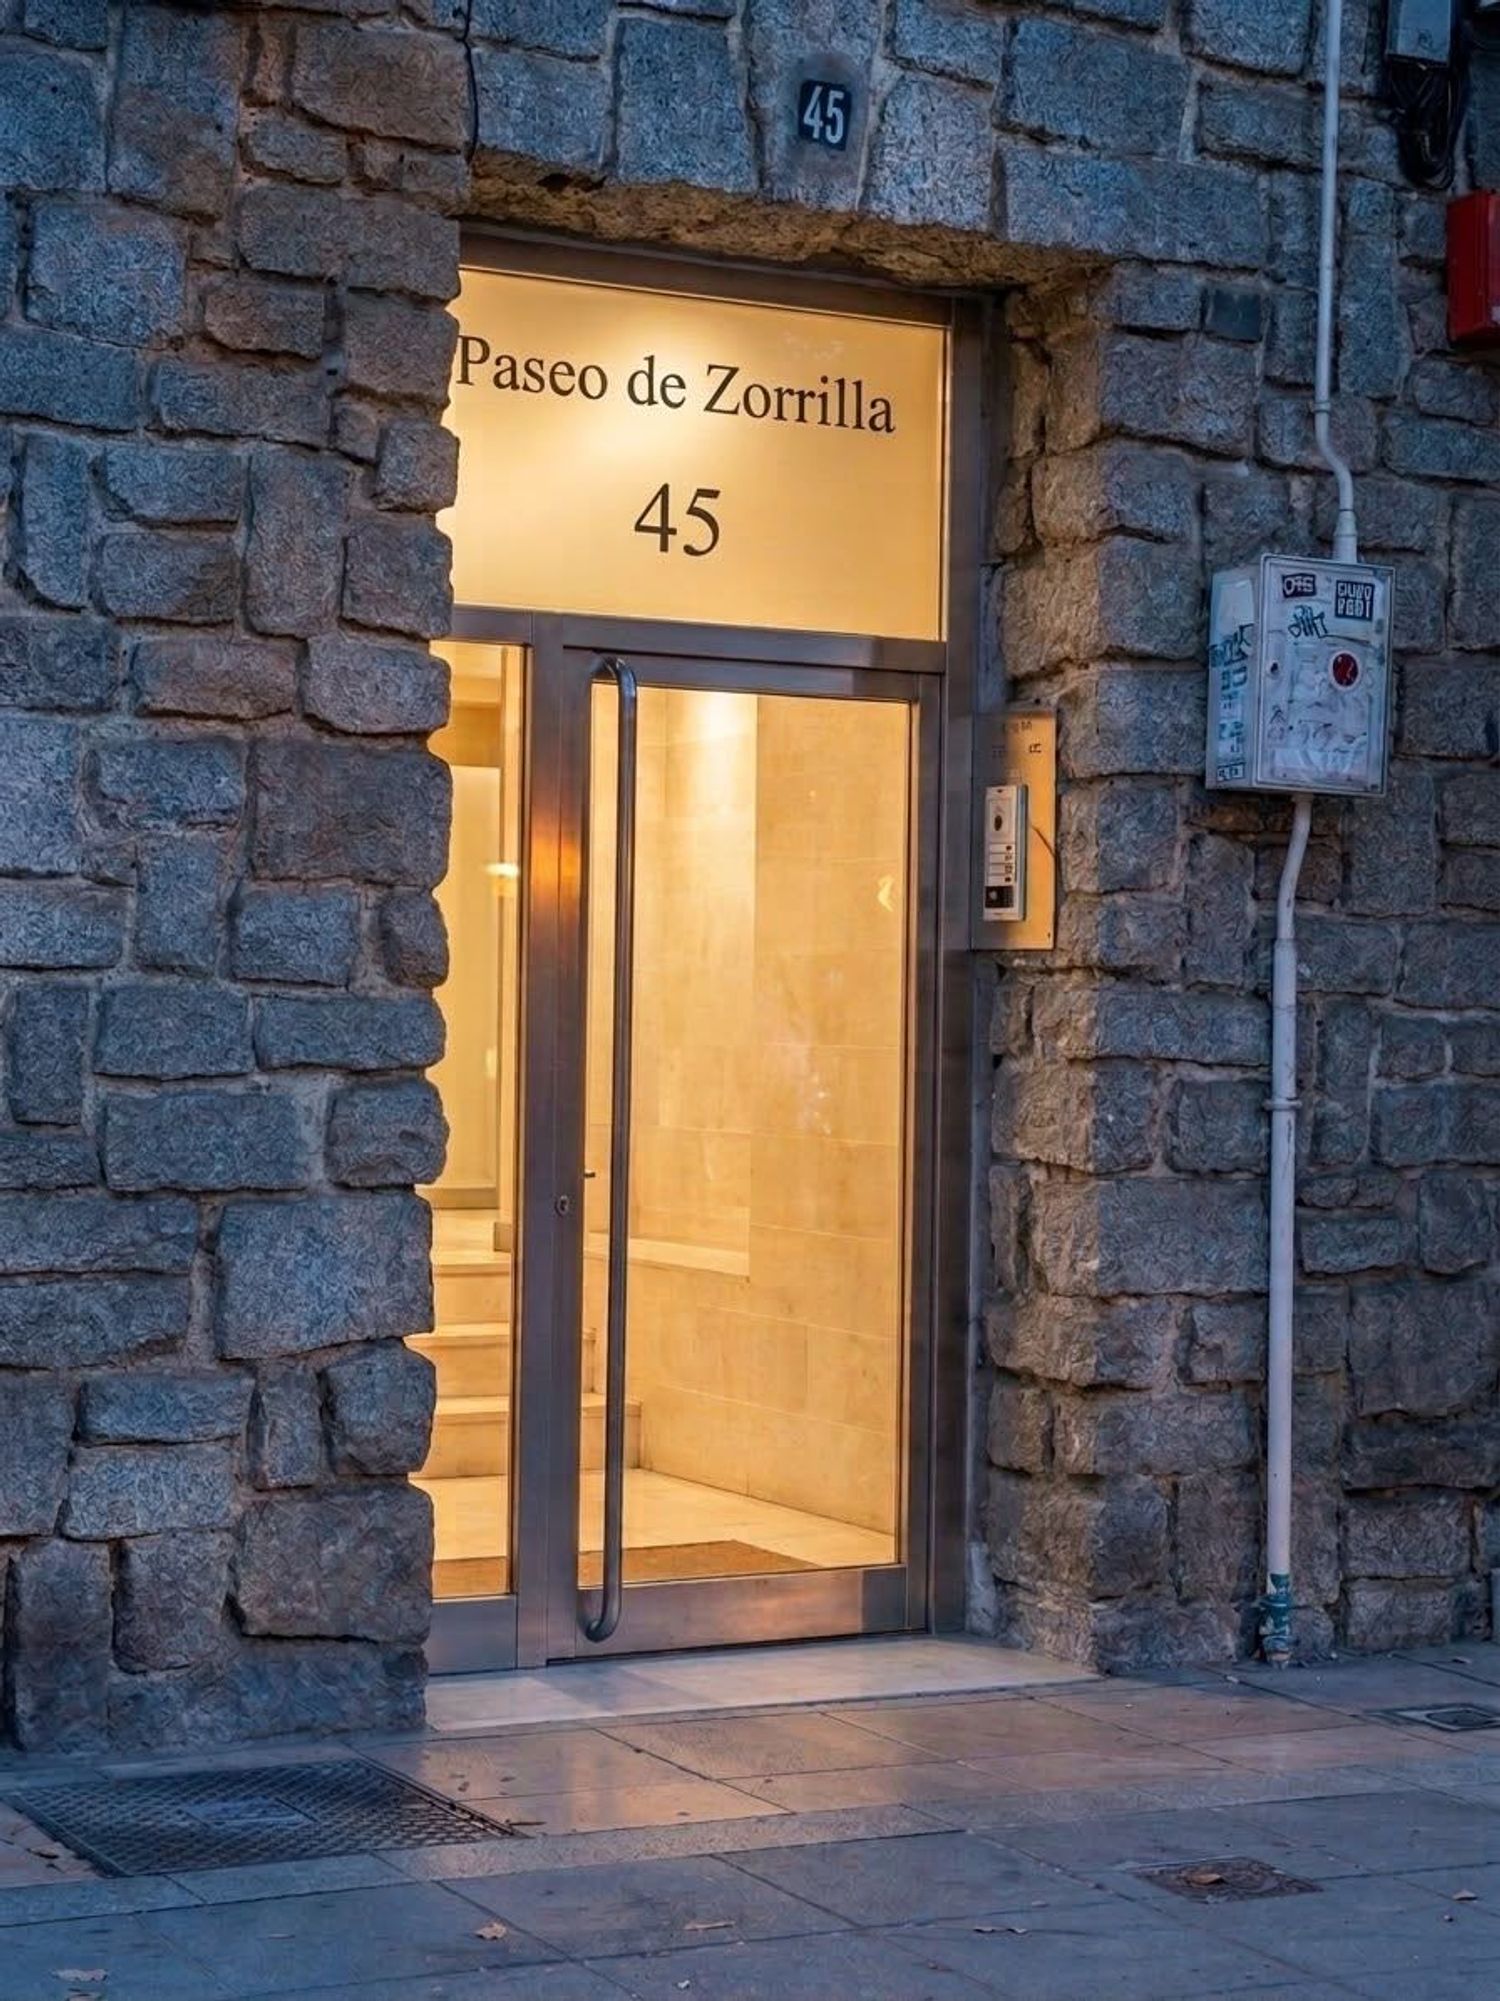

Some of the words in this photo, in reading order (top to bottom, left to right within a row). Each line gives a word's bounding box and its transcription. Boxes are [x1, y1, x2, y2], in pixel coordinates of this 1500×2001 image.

[803, 85, 846, 144] 45
[456, 334, 608, 401] Paseo
[627, 355, 686, 409] de
[703, 364, 896, 434] Zorrilla
[634, 483, 721, 557] 45
